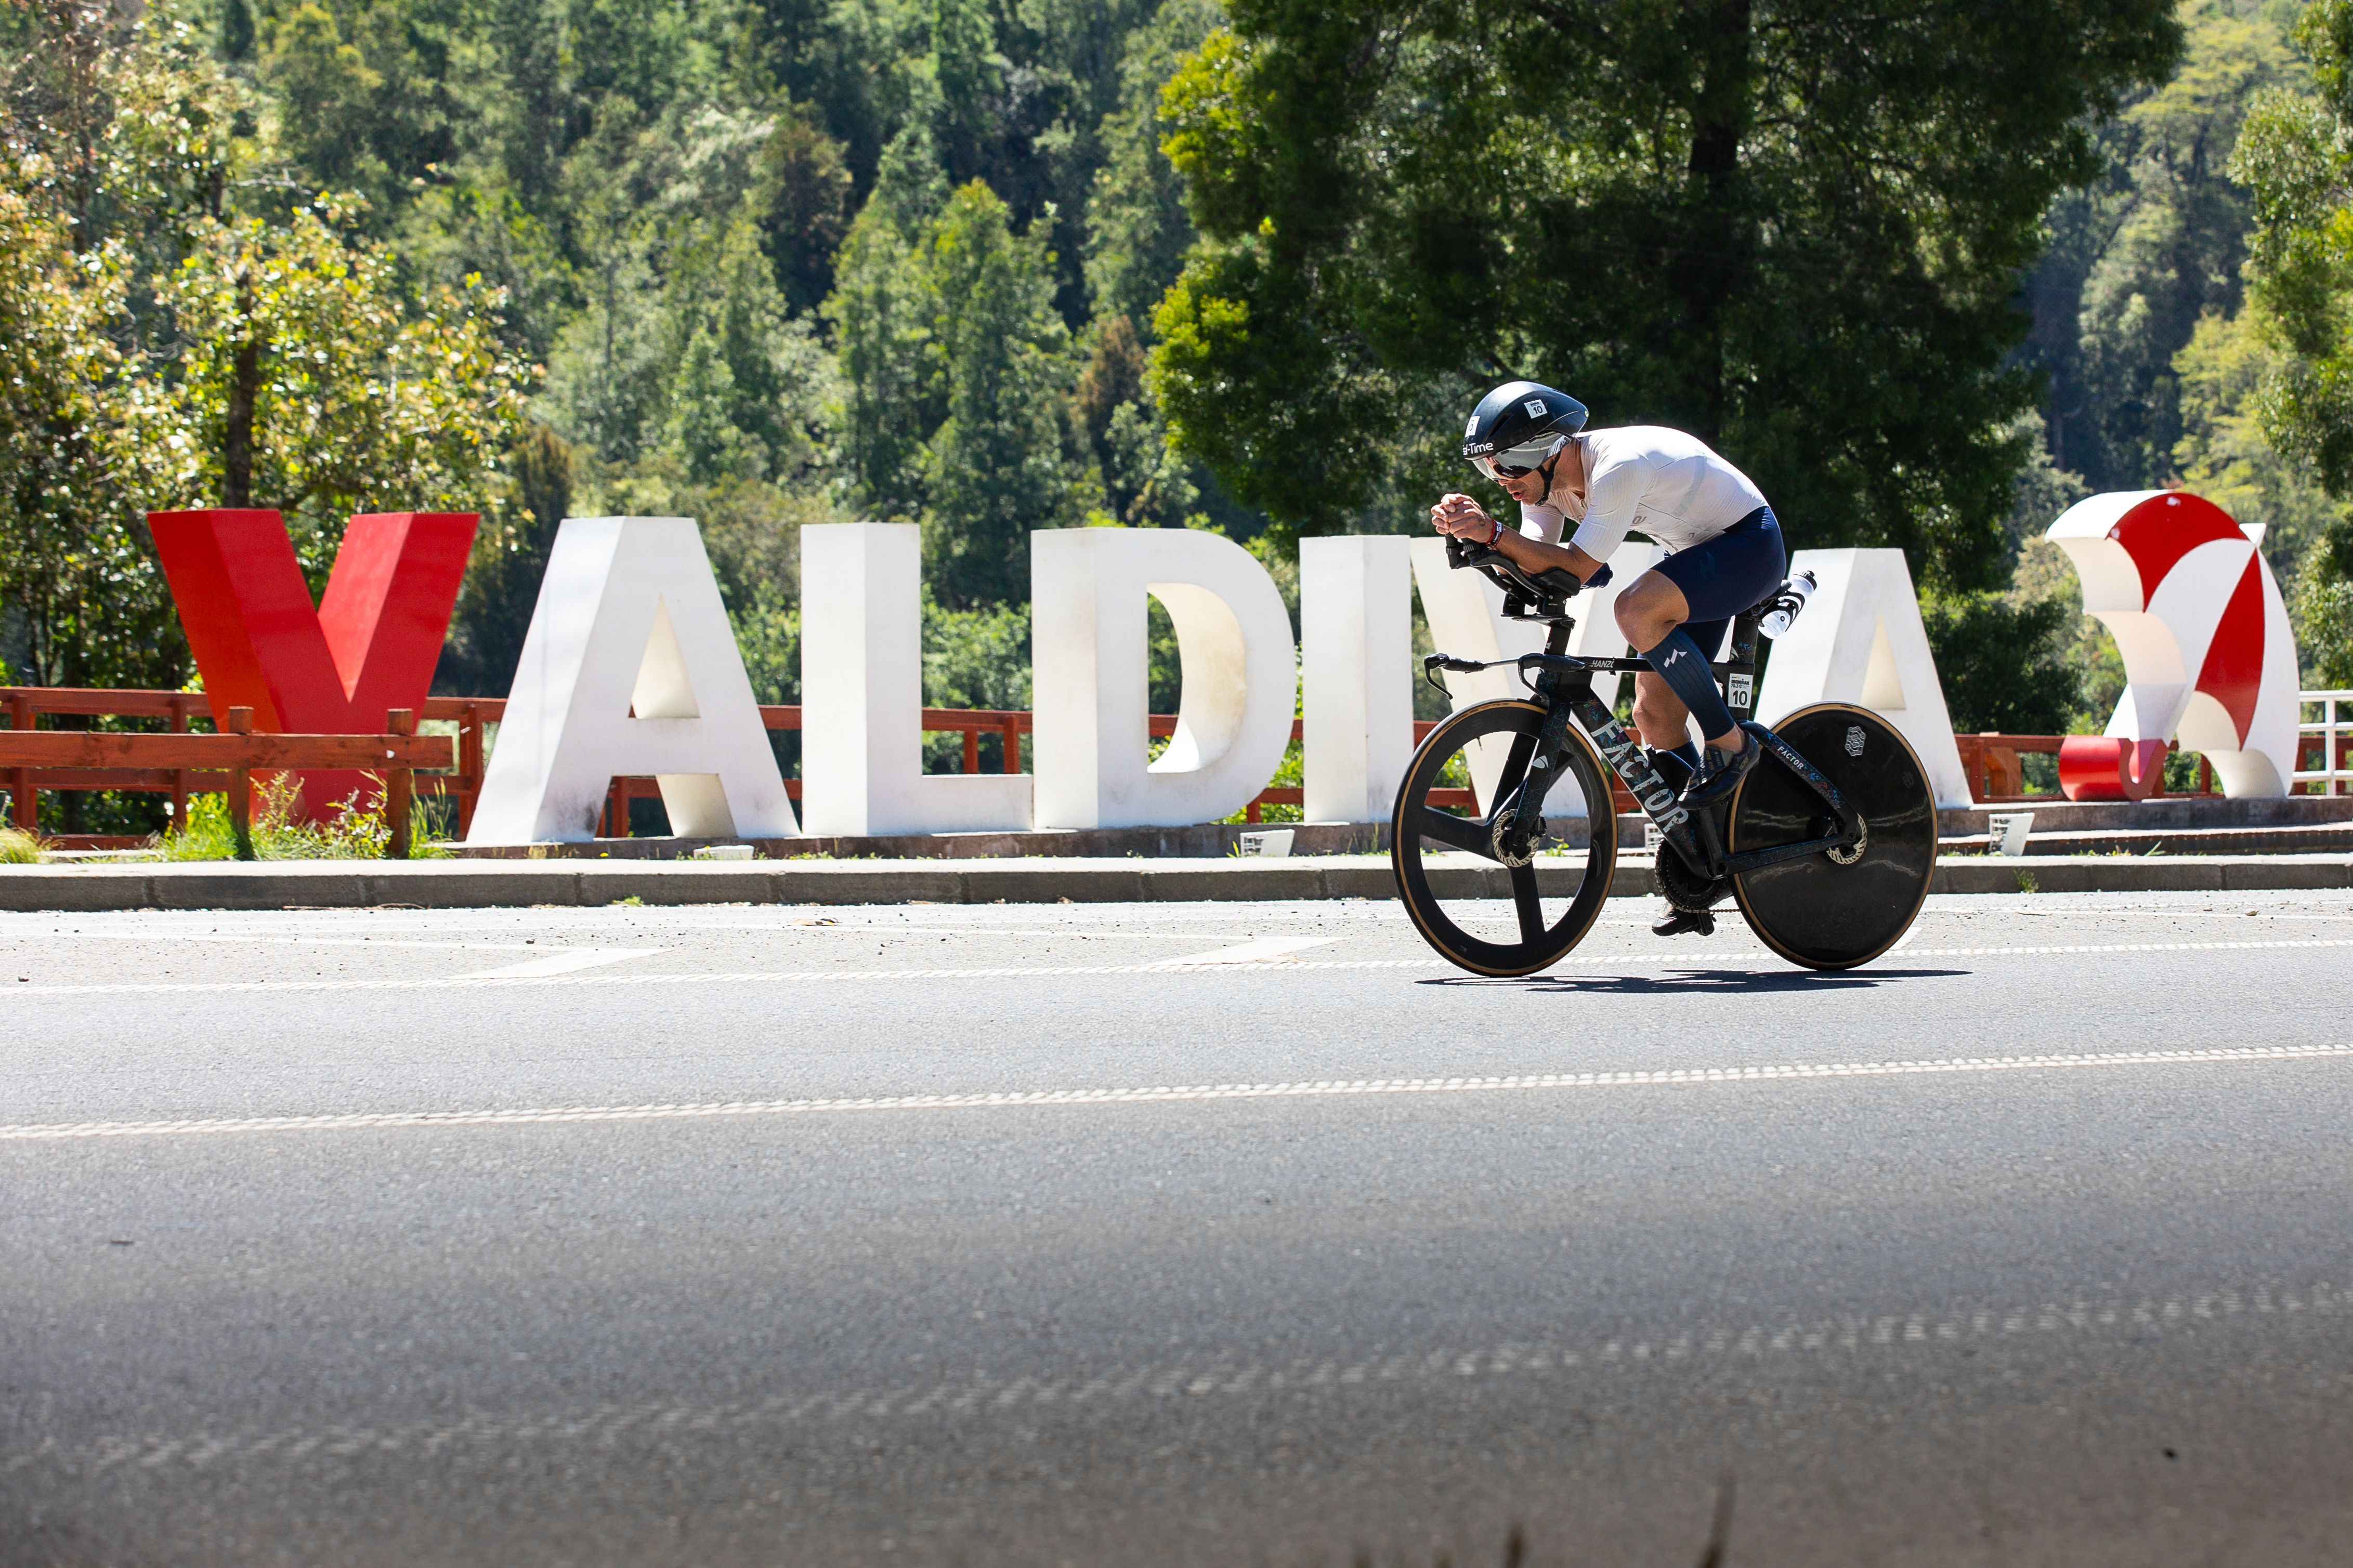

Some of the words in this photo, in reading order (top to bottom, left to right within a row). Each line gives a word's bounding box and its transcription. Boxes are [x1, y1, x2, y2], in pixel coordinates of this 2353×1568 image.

[1533, 406, 1543, 414] 10
[147, 507, 1973, 842] VALDIVA
[1733, 690, 1747, 706] 10
[1777, 746, 1804, 769] FACTOR
[1591, 719, 1689, 833] FACTOR
